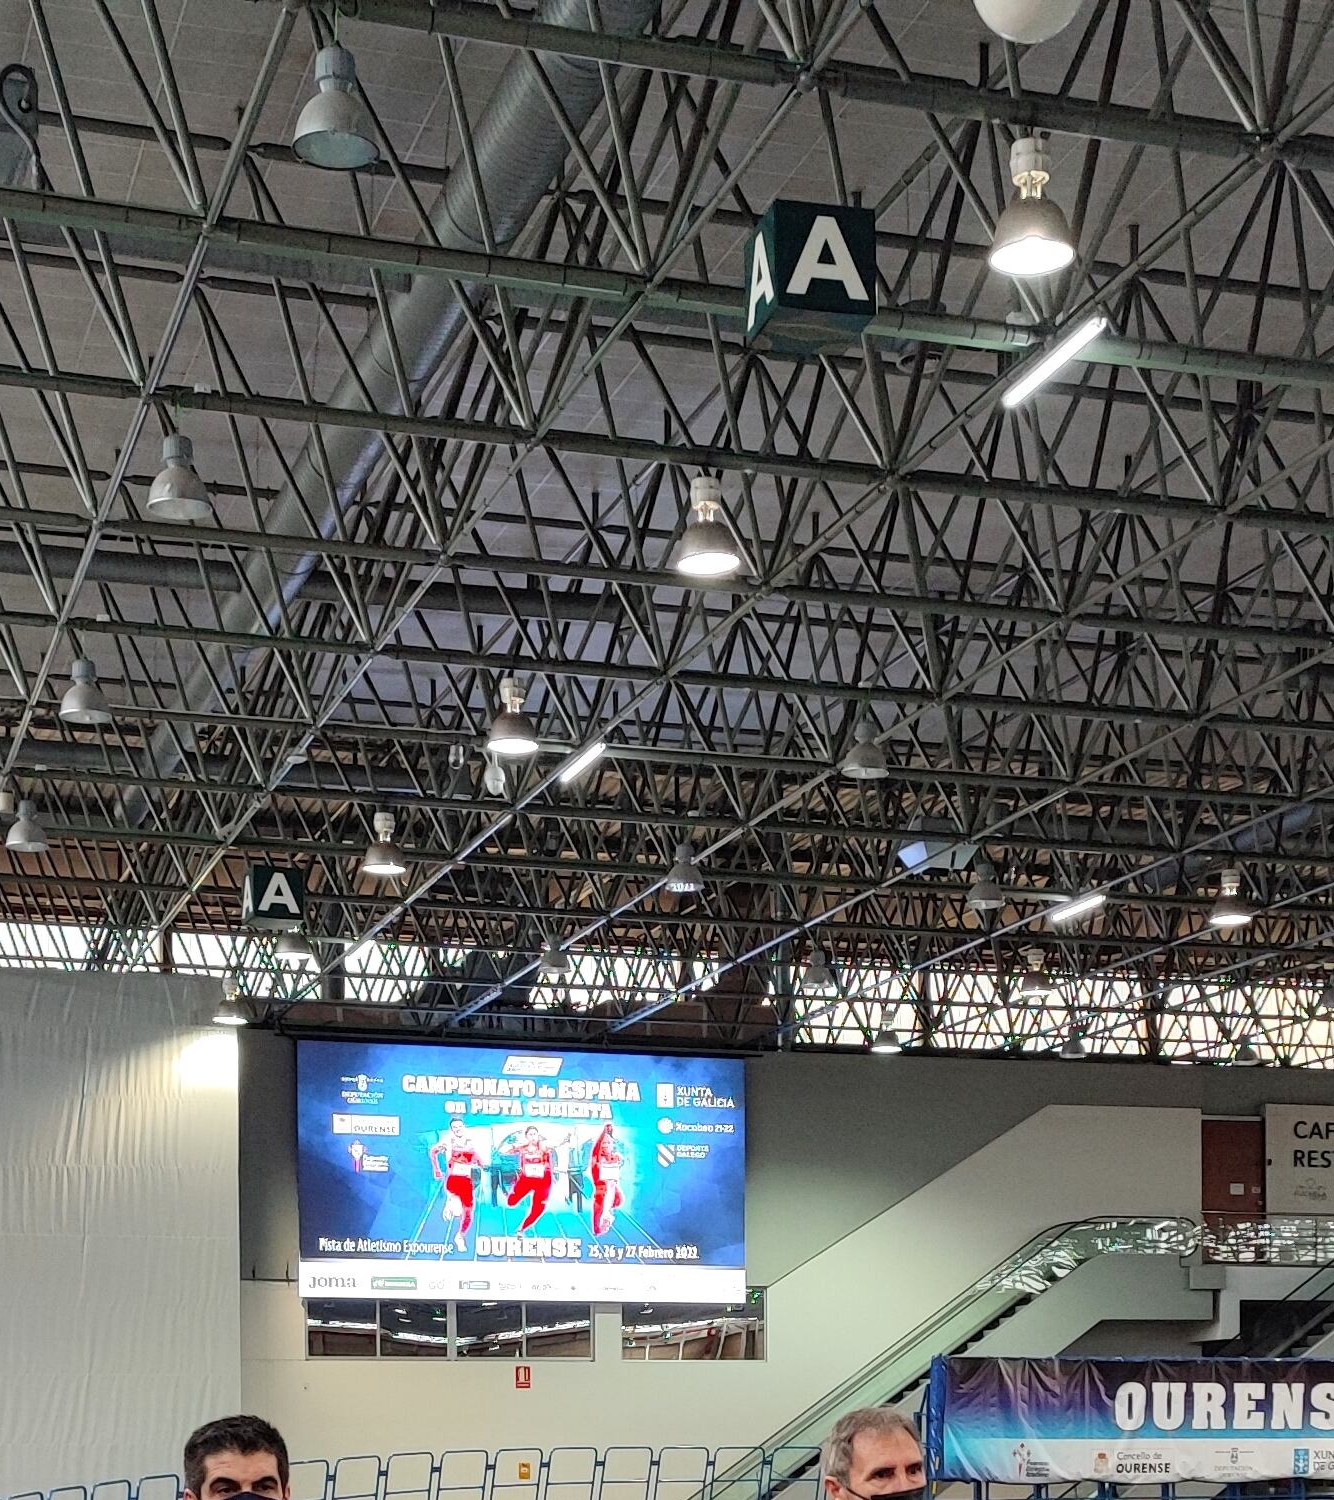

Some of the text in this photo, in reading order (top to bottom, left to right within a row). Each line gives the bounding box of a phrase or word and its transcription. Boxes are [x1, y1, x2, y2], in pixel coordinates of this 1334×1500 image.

[785, 215, 870, 301] A
[747, 231, 775, 332] A
[242, 875, 254, 920] A
[257, 872, 301, 915] A
[402, 1074, 536, 1098] CAMPEONATO
[558, 1078, 641, 1101] ESPAÑA
[676, 1086, 713, 1098] XUNTA
[470, 1099, 523, 1116] PISTA
[676, 1097, 735, 1108] DE GALICIA
[319, 1237, 453, 1254] Pista de Atletismo Expourense
[477, 1235, 582, 1258] OURENSE
[604, 1246, 616, 1258] 26
[617, 1247, 624, 1260] y
[626, 1246, 637, 1258] 27
[638, 1245, 673, 1259] Febrero
[1116, 1451, 1162, 1461] Concello de
[1116, 1461, 1170, 1475] OURENSE
